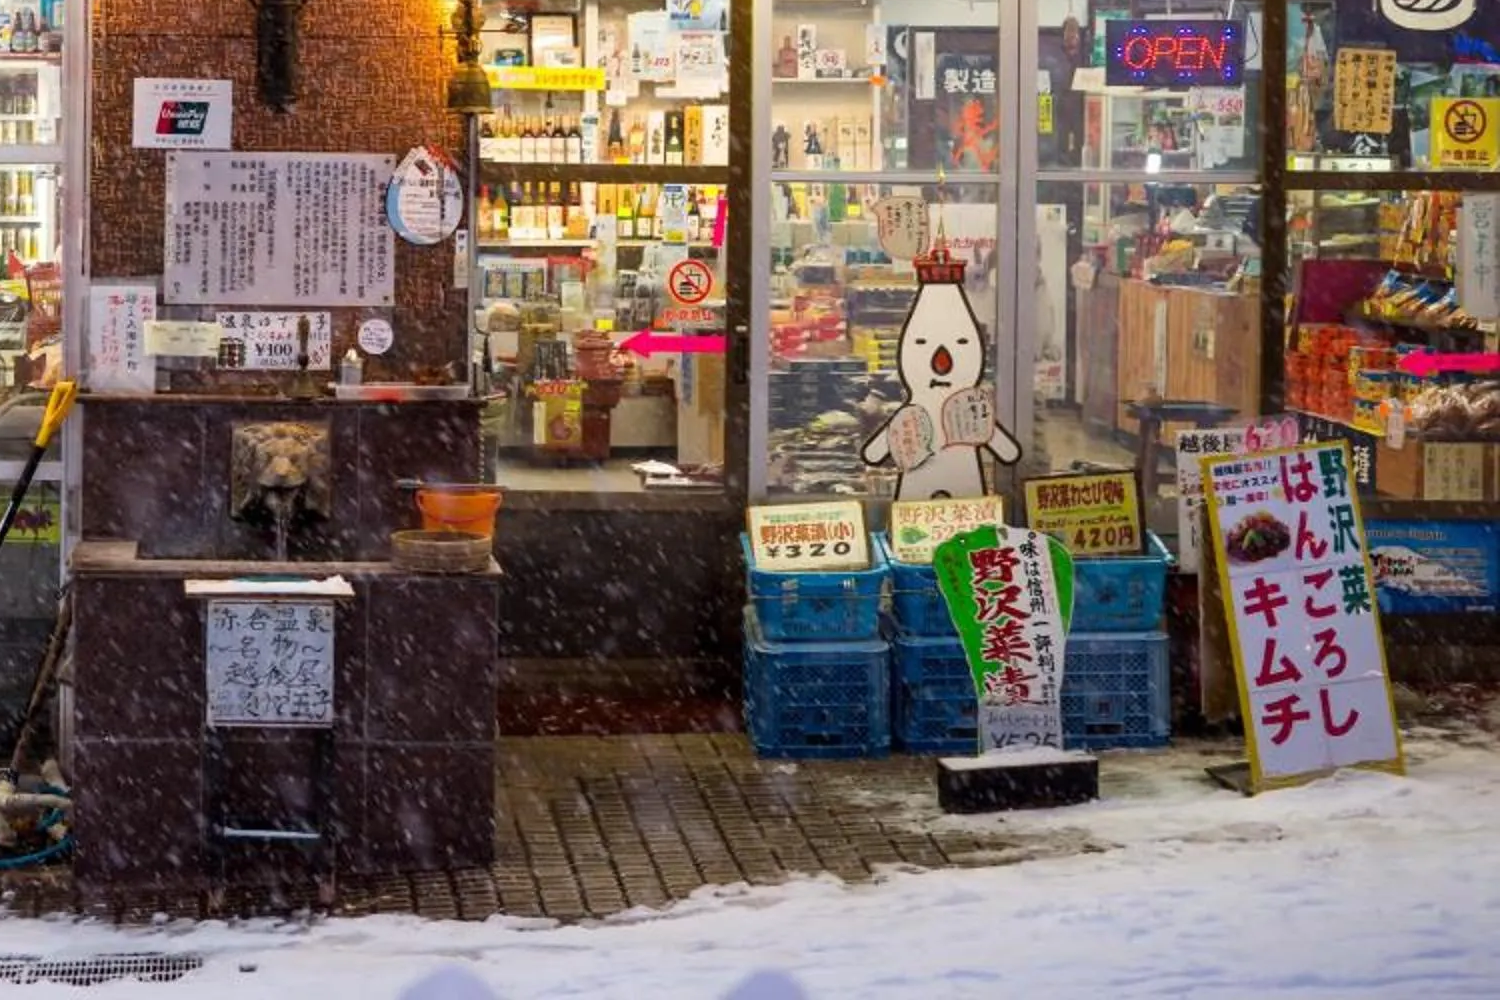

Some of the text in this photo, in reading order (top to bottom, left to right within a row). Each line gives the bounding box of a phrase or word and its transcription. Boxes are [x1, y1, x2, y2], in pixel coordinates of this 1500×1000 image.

[1124, 36, 1226, 69] OPEN
[220, 313, 325, 329] 温泉ゆで子
[759, 521, 856, 544] 野沢菜漬(小)
[1073, 525, 1133, 549] 420円
[1316, 447, 1373, 616] 野沢菜
[766, 541, 852, 558] ¥320
[1278, 450, 1360, 739] はんころし
[968, 546, 1043, 707] 野沢菜漬
[1243, 577, 1311, 746] キムチ
